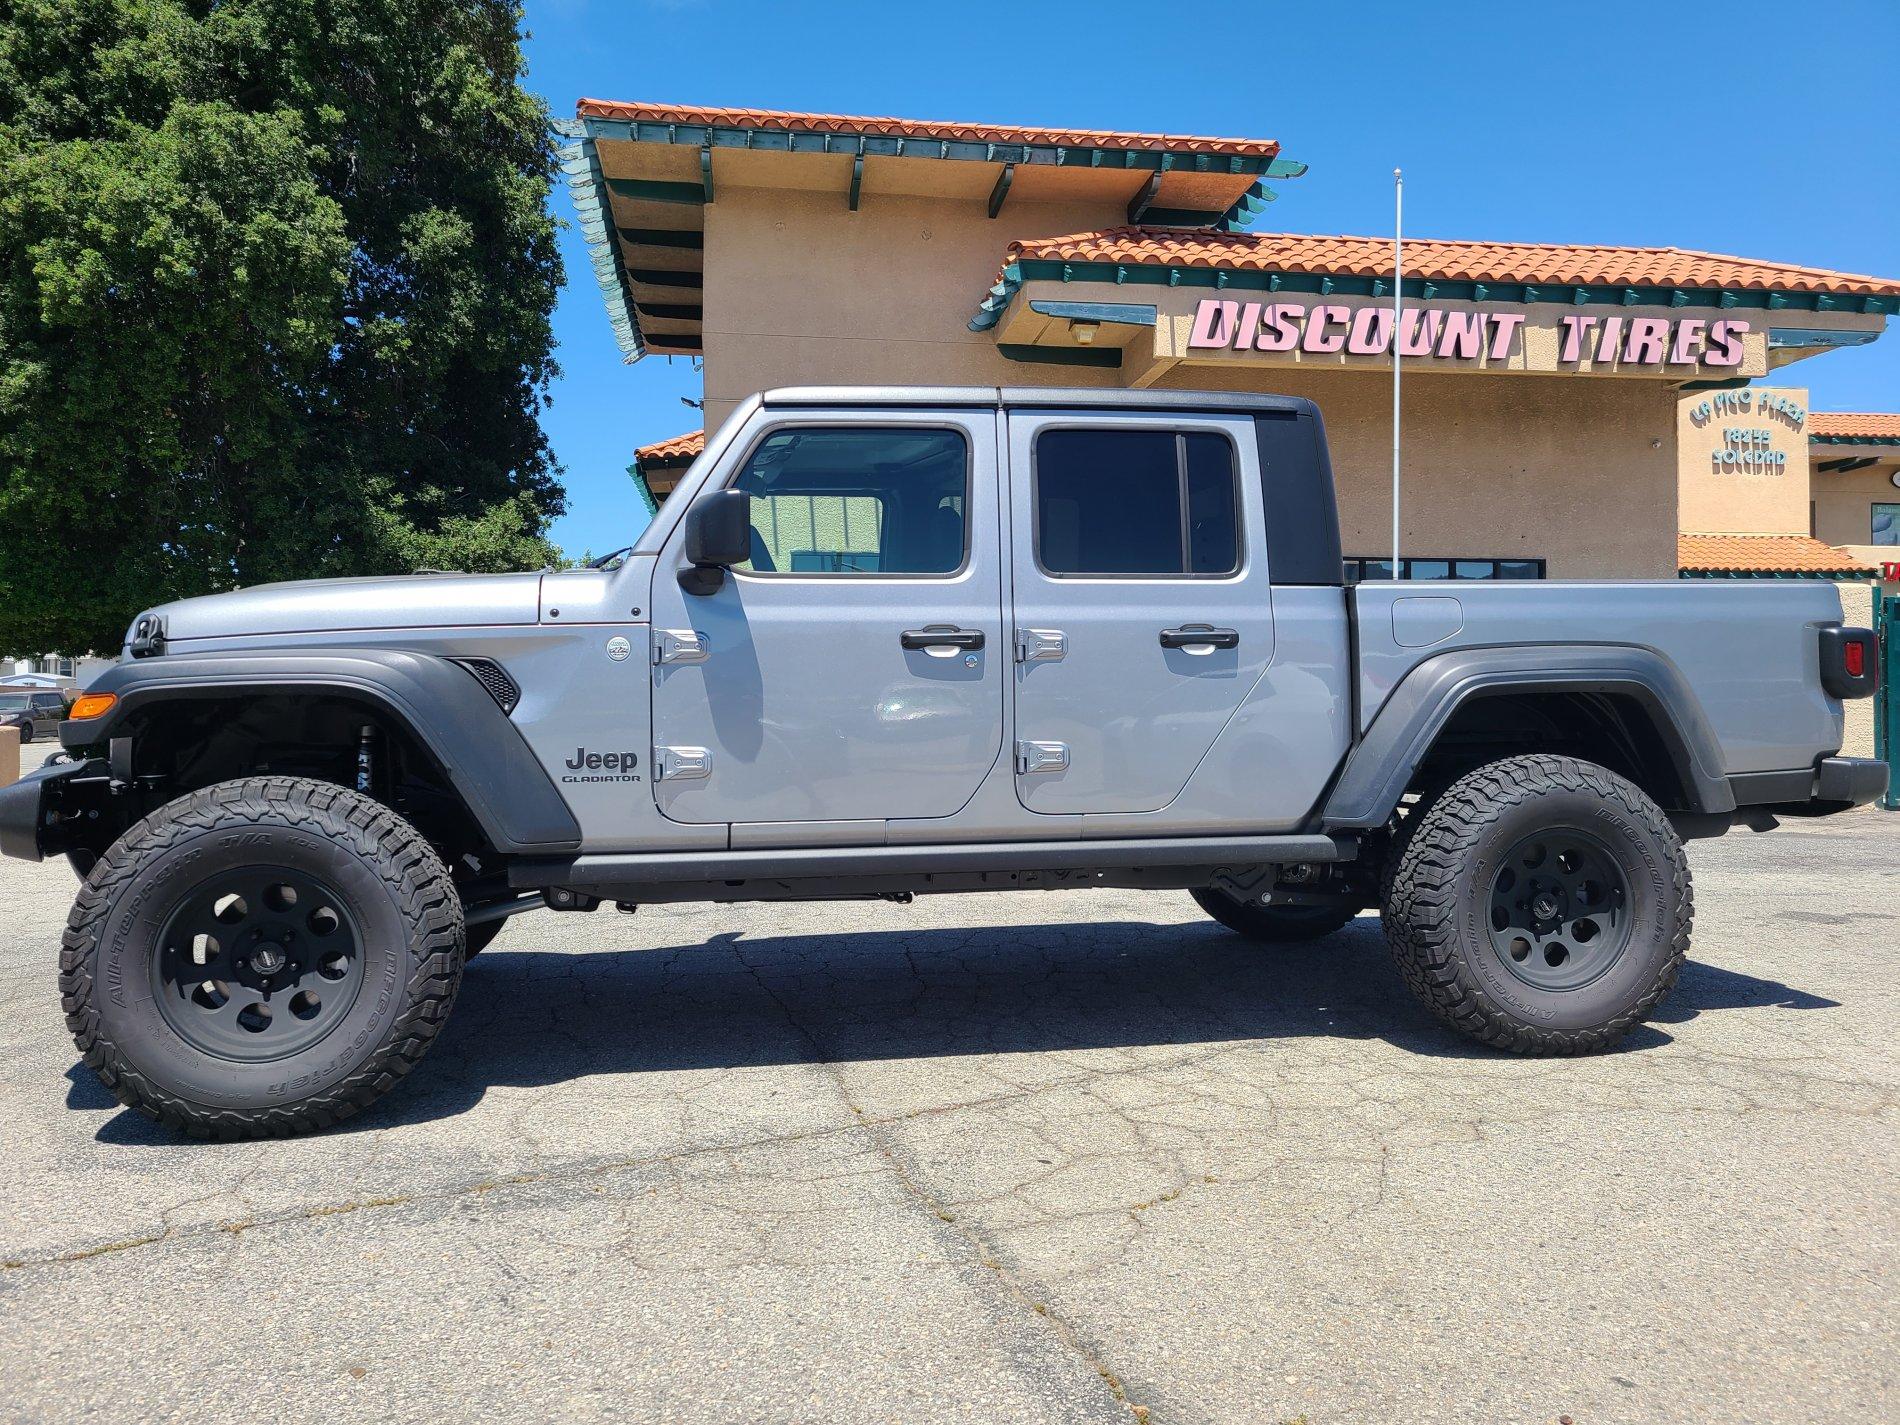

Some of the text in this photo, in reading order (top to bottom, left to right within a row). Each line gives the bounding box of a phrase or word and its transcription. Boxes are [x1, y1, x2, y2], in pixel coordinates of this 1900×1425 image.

[1188, 299, 1750, 366] DISCOUNT TIRES
[1690, 388, 1806, 424] LA PICO PLAZA
[1711, 448, 1787, 465] SOLEDAD
[565, 746, 638, 774] Jeep
[561, 775, 642, 783] GLADIATOR
